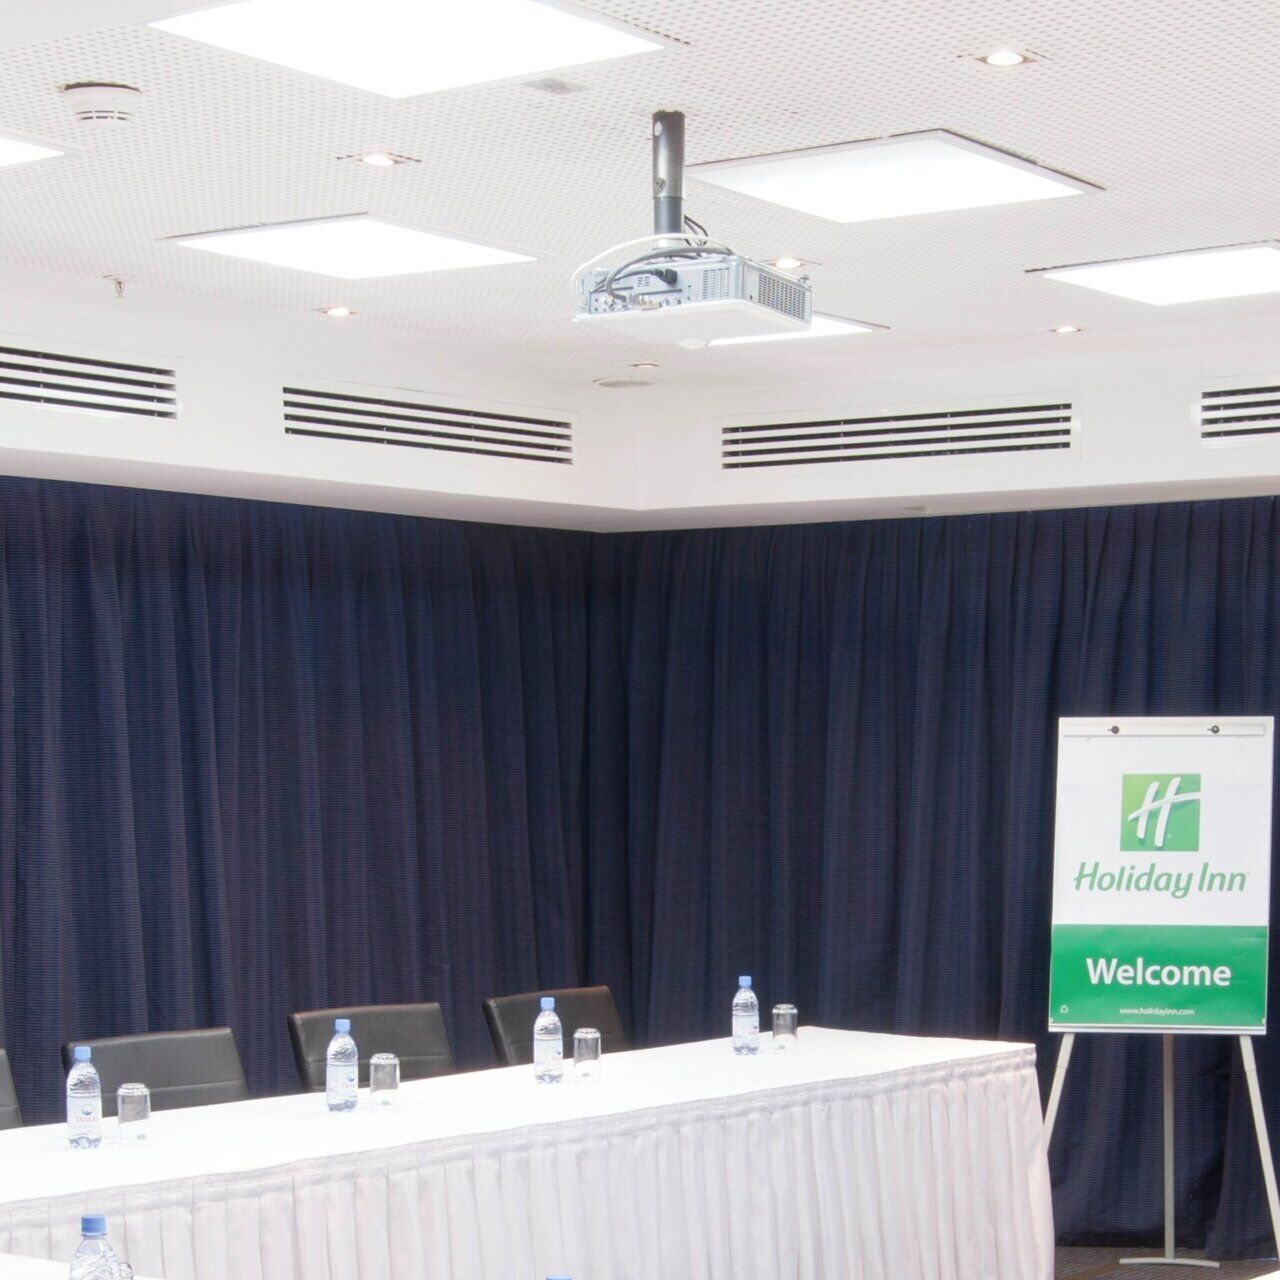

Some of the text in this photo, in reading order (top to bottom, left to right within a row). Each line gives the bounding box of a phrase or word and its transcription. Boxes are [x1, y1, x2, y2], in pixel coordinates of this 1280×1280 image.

[1073, 861, 1247, 899] Holiday Inn
[1086, 957, 1231, 987] Welcome
[1119, 1006, 1196, 1017] www.holidayinn.com
